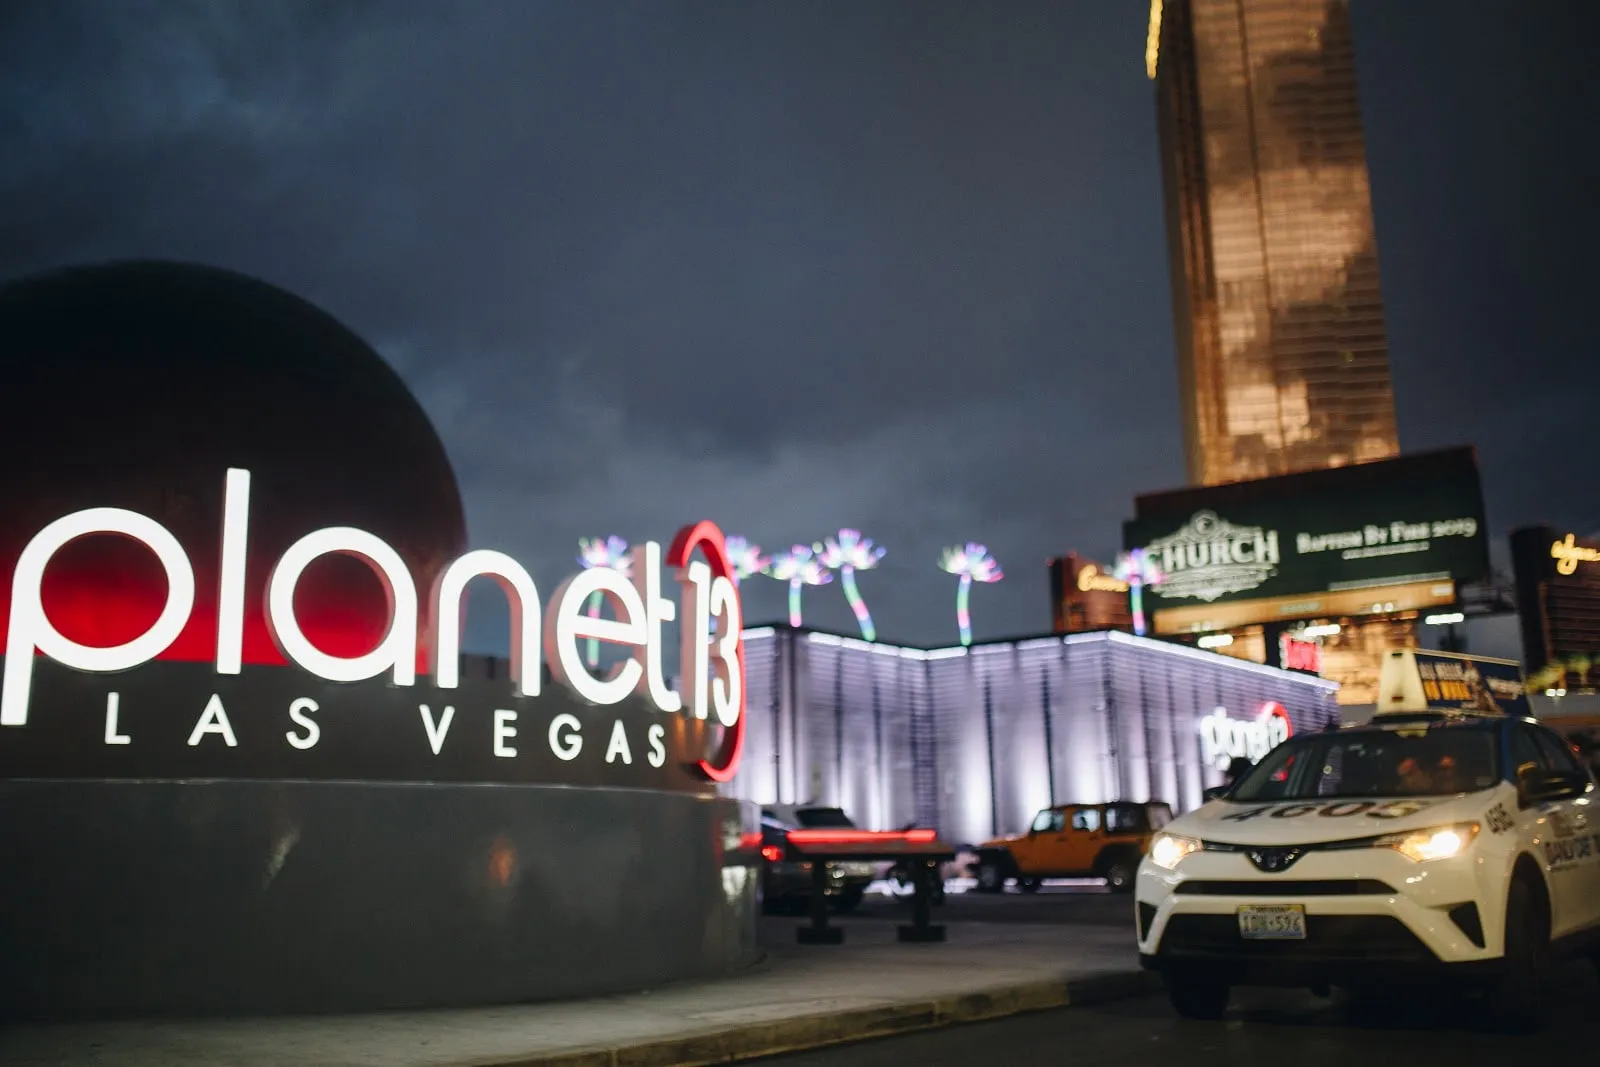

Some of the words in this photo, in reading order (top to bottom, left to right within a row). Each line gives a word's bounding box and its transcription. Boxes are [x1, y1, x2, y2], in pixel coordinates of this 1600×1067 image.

[1, 467, 682, 727] planet
[686, 560, 743, 728] 13
[105, 692, 321, 750] LAS
[419, 704, 666, 768] VEGAS
